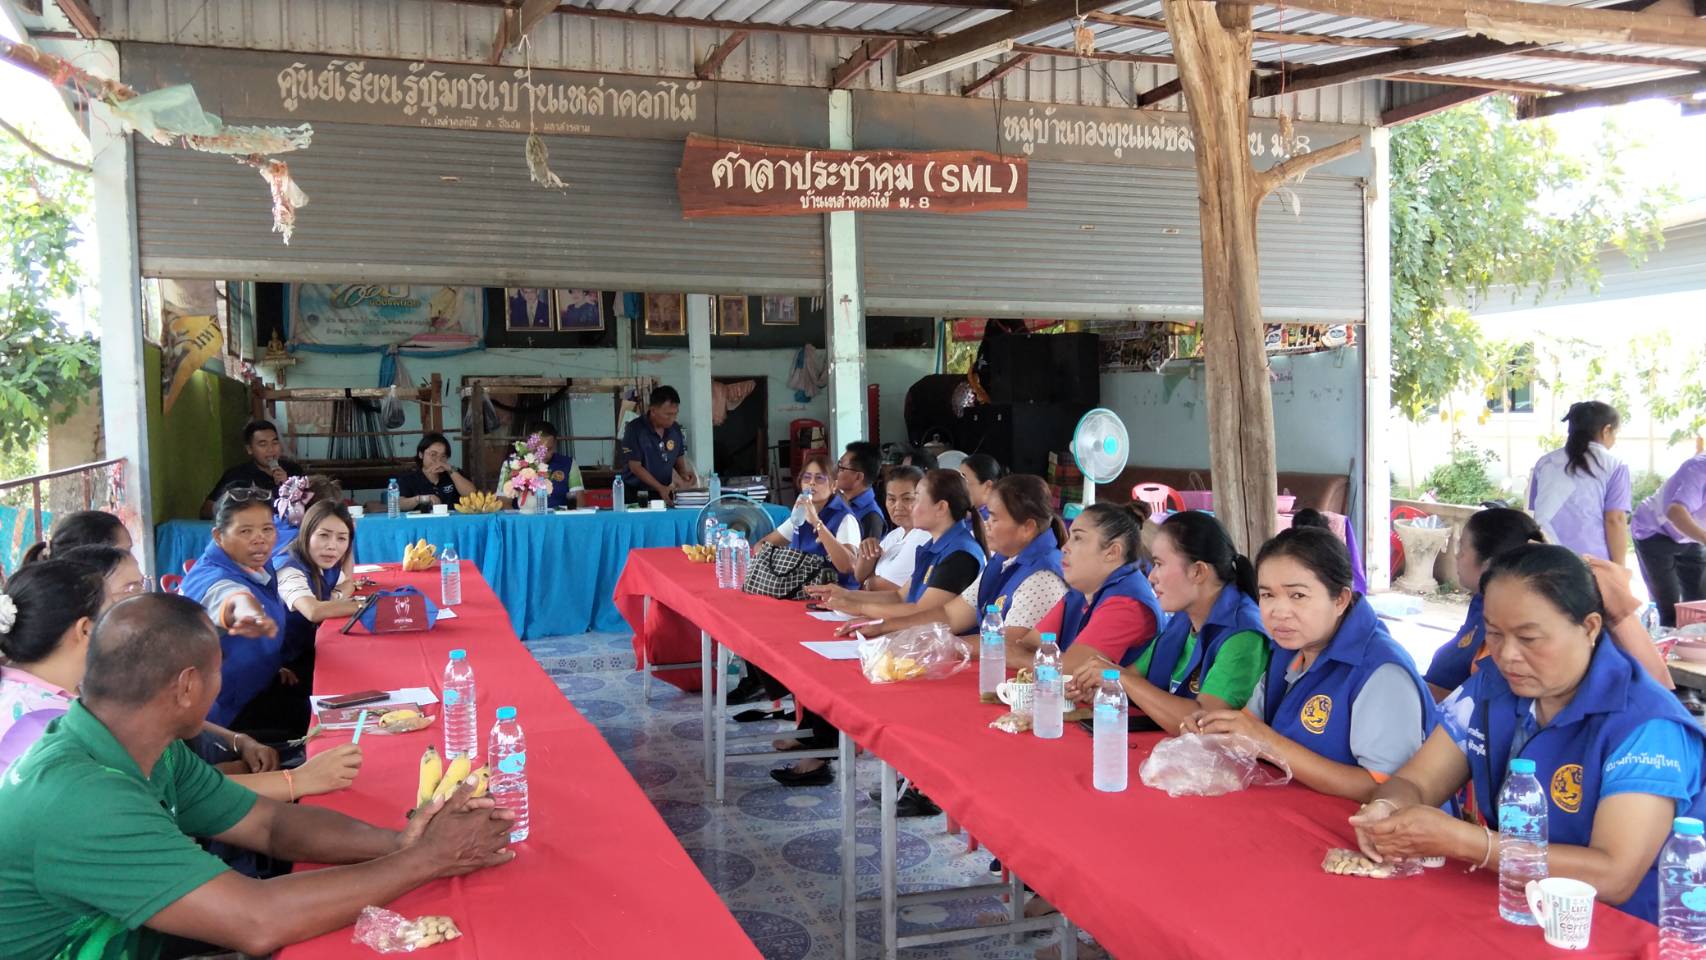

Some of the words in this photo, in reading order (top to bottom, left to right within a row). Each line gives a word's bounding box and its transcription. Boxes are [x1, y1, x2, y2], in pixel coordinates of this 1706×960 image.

[711, 151, 914, 192] ศาลาประชาคม
[924, 161, 1018, 194] (SML)
[799, 189, 893, 209] บ้านเหล่าดอกไม้
